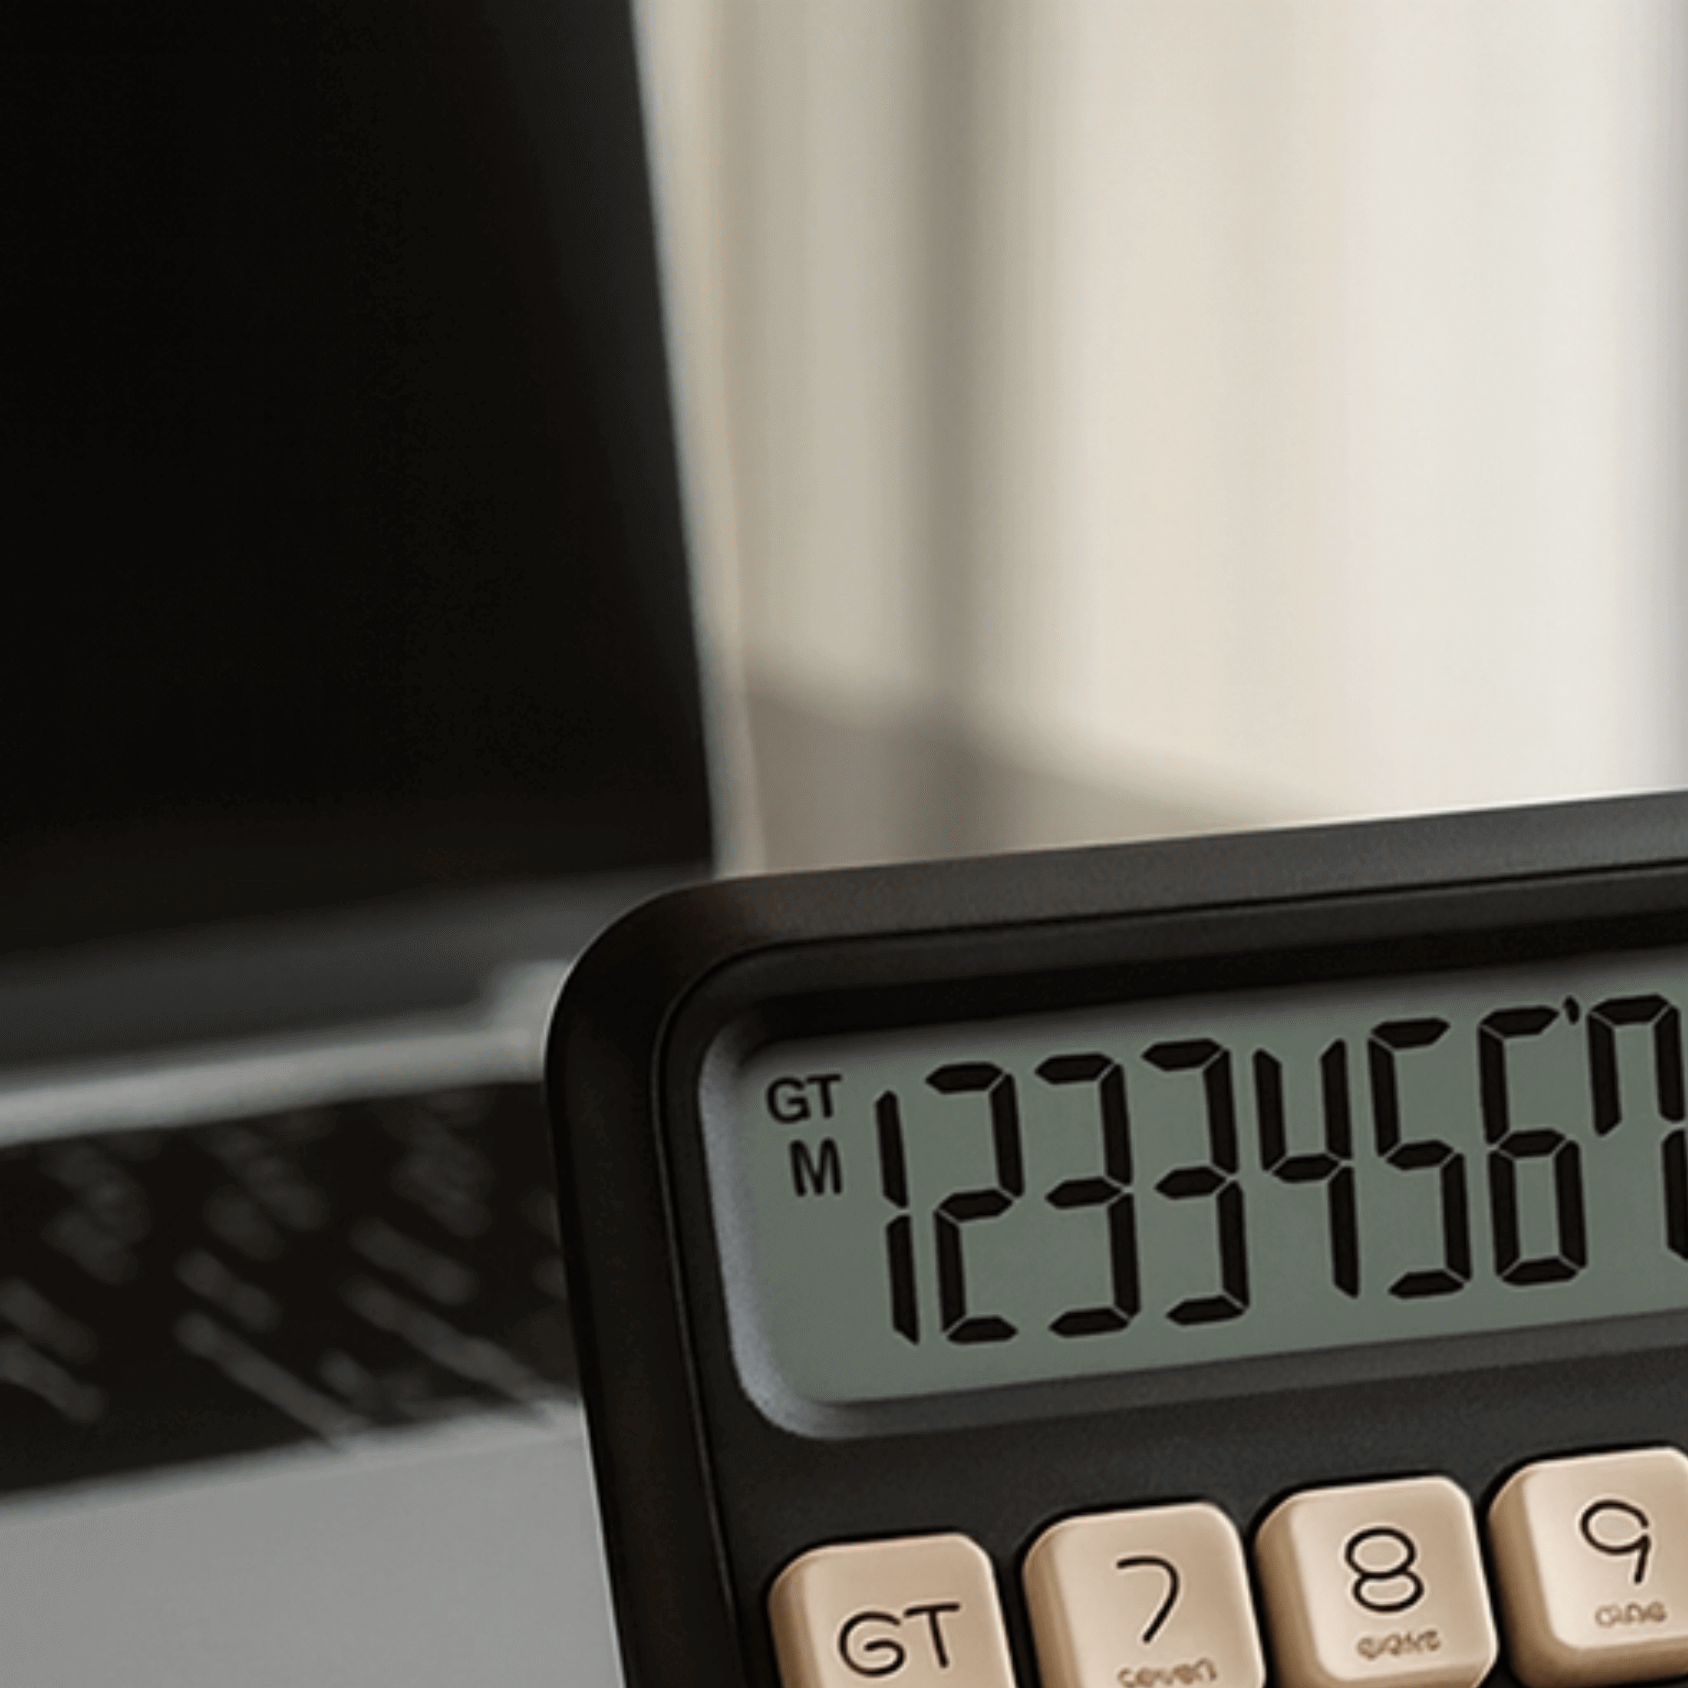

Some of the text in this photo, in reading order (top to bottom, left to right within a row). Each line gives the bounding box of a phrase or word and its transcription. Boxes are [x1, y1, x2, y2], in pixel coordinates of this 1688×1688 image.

[766, 1074, 841, 1124] GT
[789, 1138, 843, 1197] M
[1344, 1527, 1424, 1614] 8
[1579, 1499, 1651, 1584] 9
[838, 1602, 961, 1678] GT
[1116, 1556, 1179, 1644] 7
